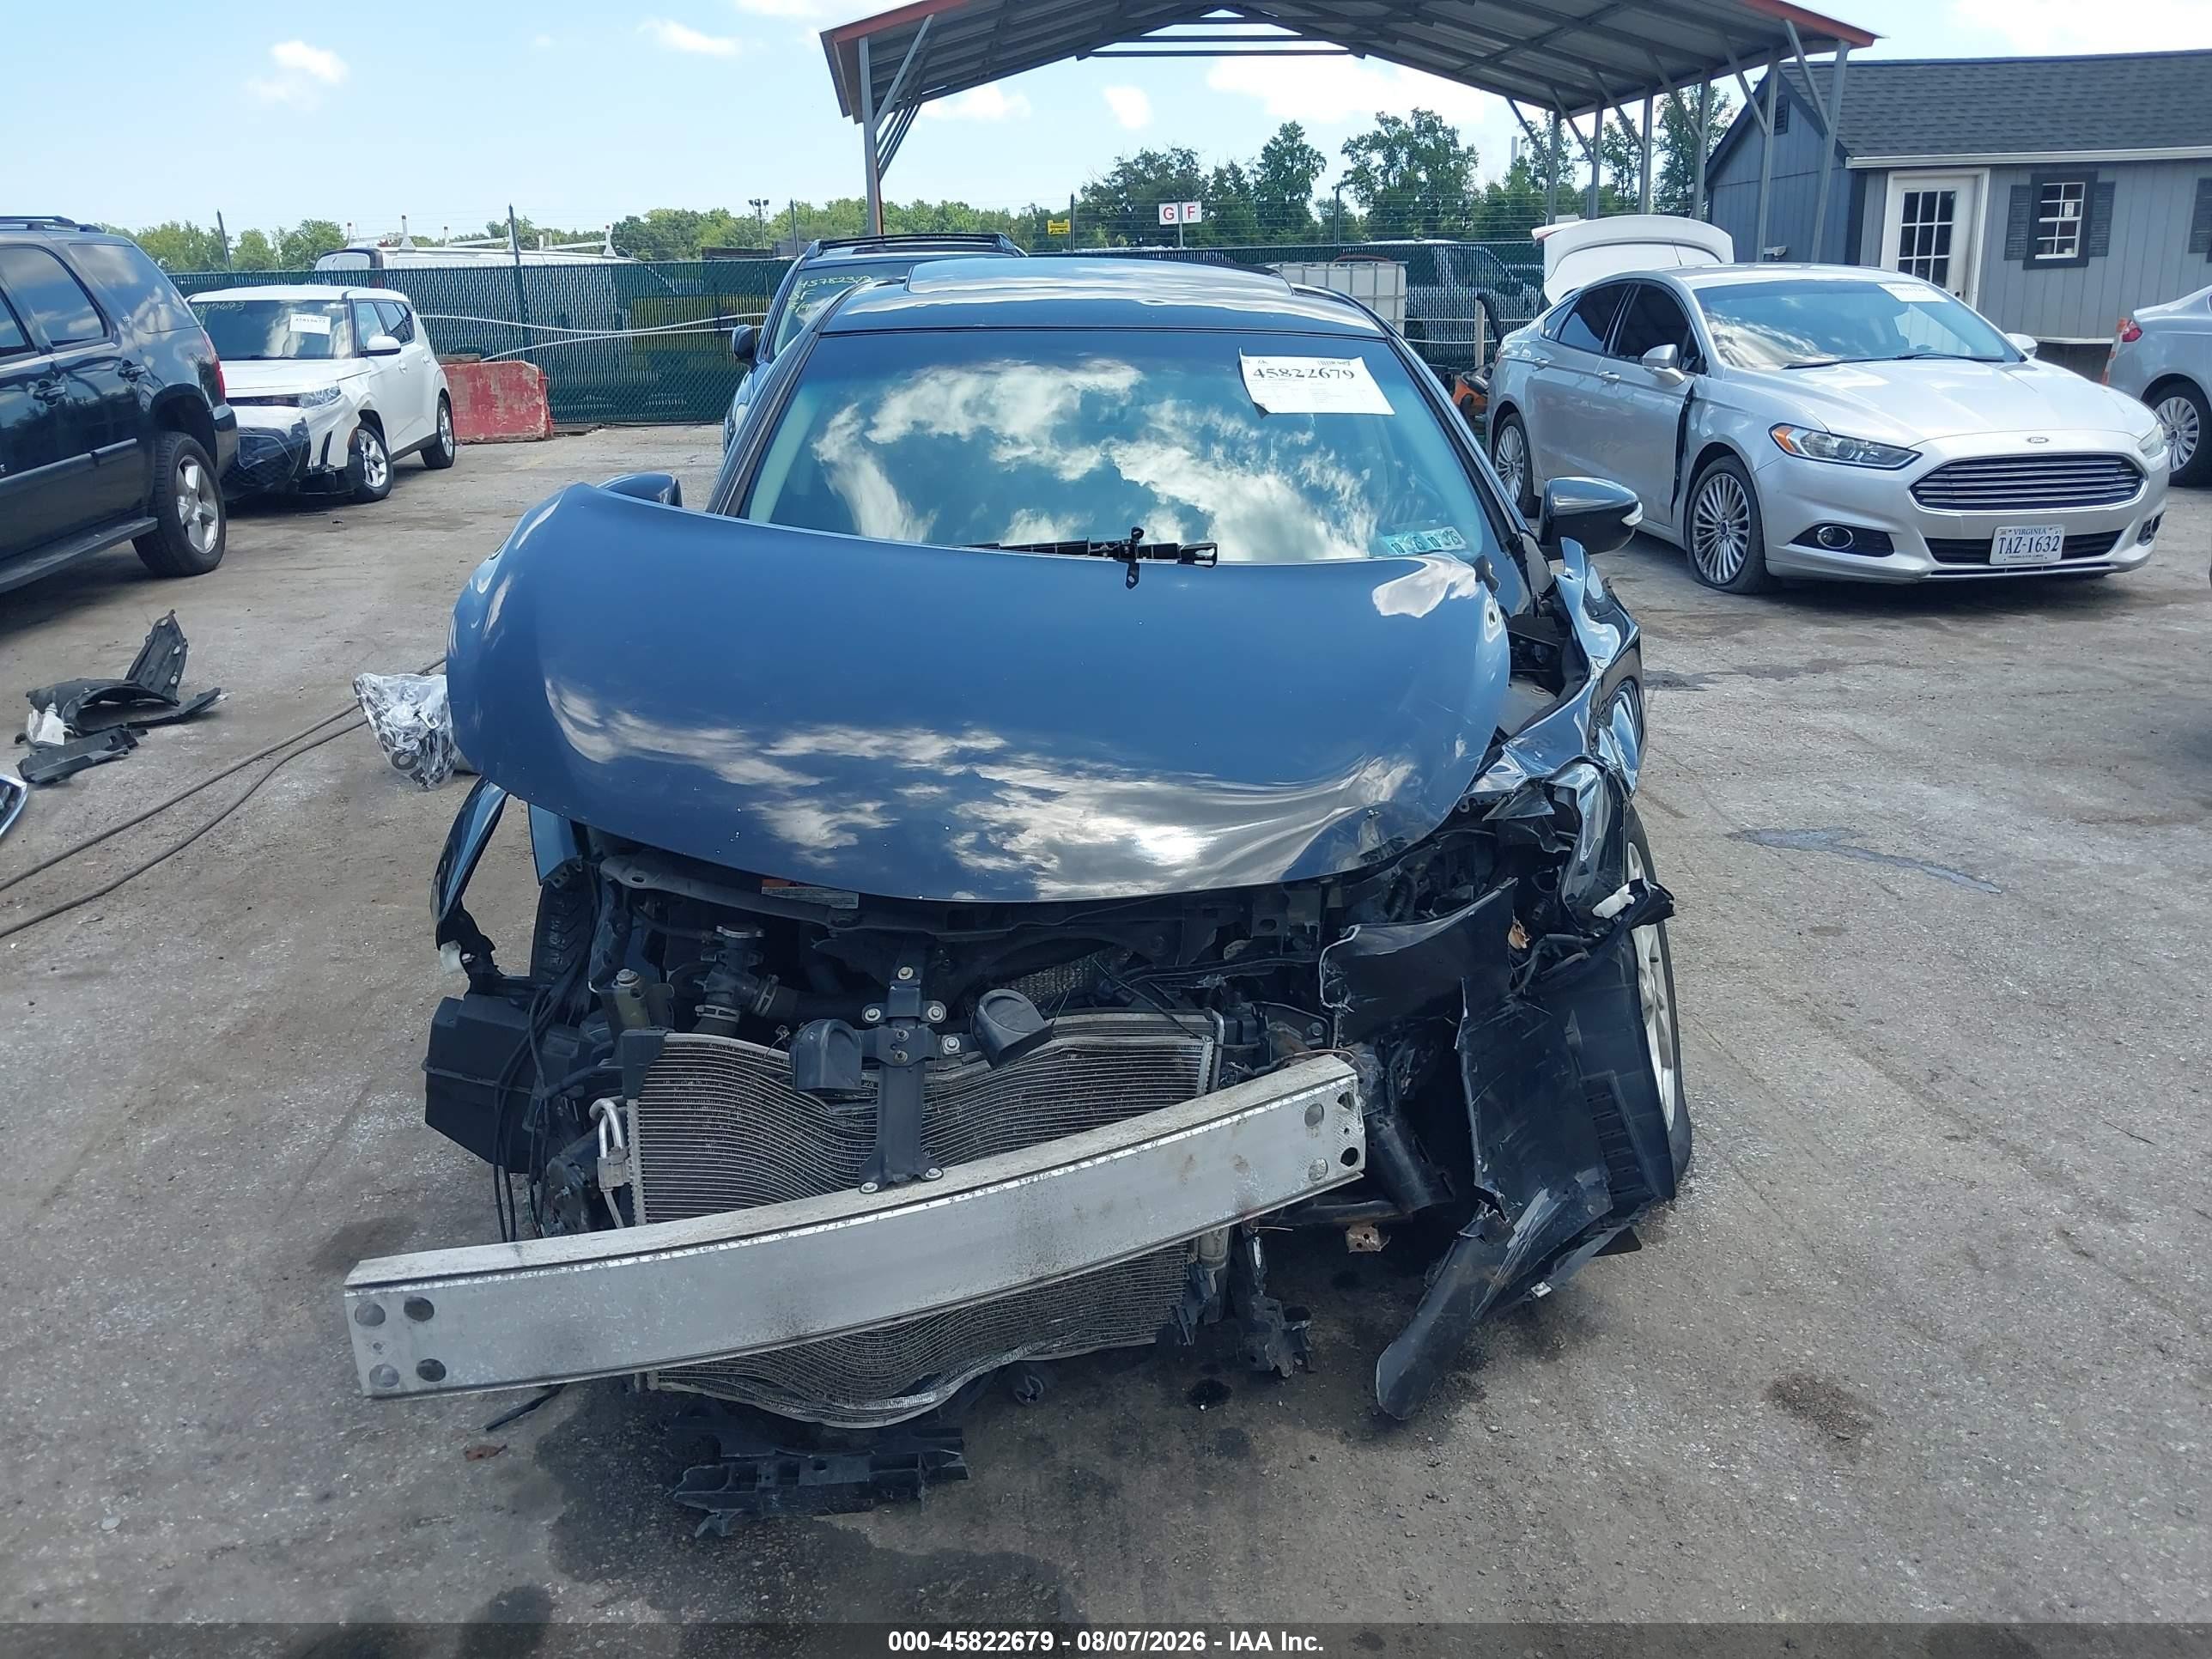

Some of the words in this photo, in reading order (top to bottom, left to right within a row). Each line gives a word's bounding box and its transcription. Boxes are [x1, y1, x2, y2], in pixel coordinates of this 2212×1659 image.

[1164, 207, 1175, 220] G
[1188, 206, 1195, 219] F
[1253, 368, 1355, 380] 45822679
[1998, 535, 2060, 554] TAZ-1632
